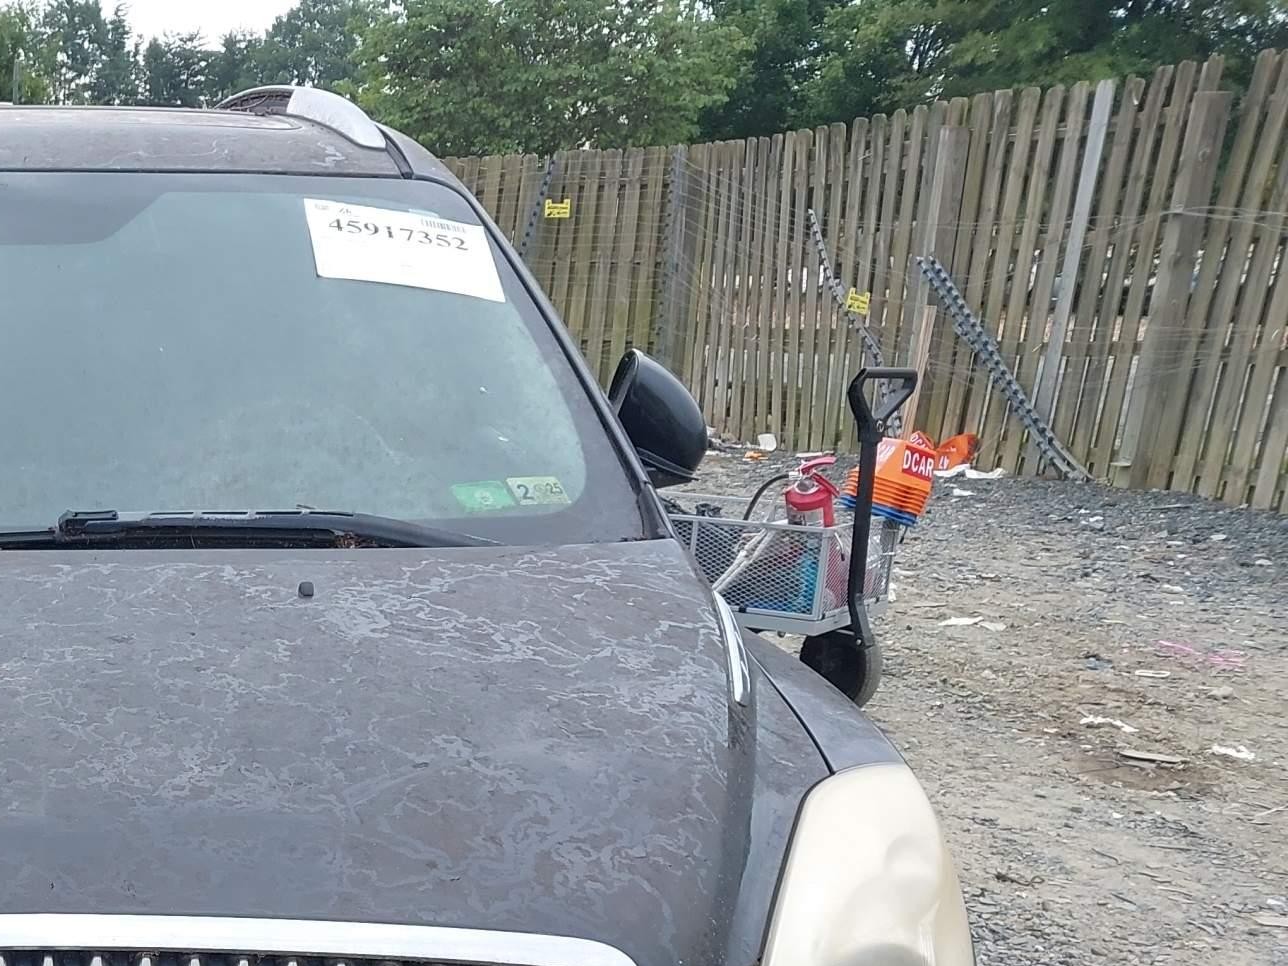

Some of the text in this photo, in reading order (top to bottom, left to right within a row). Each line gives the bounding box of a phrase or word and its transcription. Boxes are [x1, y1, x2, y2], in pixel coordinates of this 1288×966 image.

[328, 217, 470, 252] 45917352
[903, 450, 934, 477] DCAR
[516, 483, 534, 500] 2
